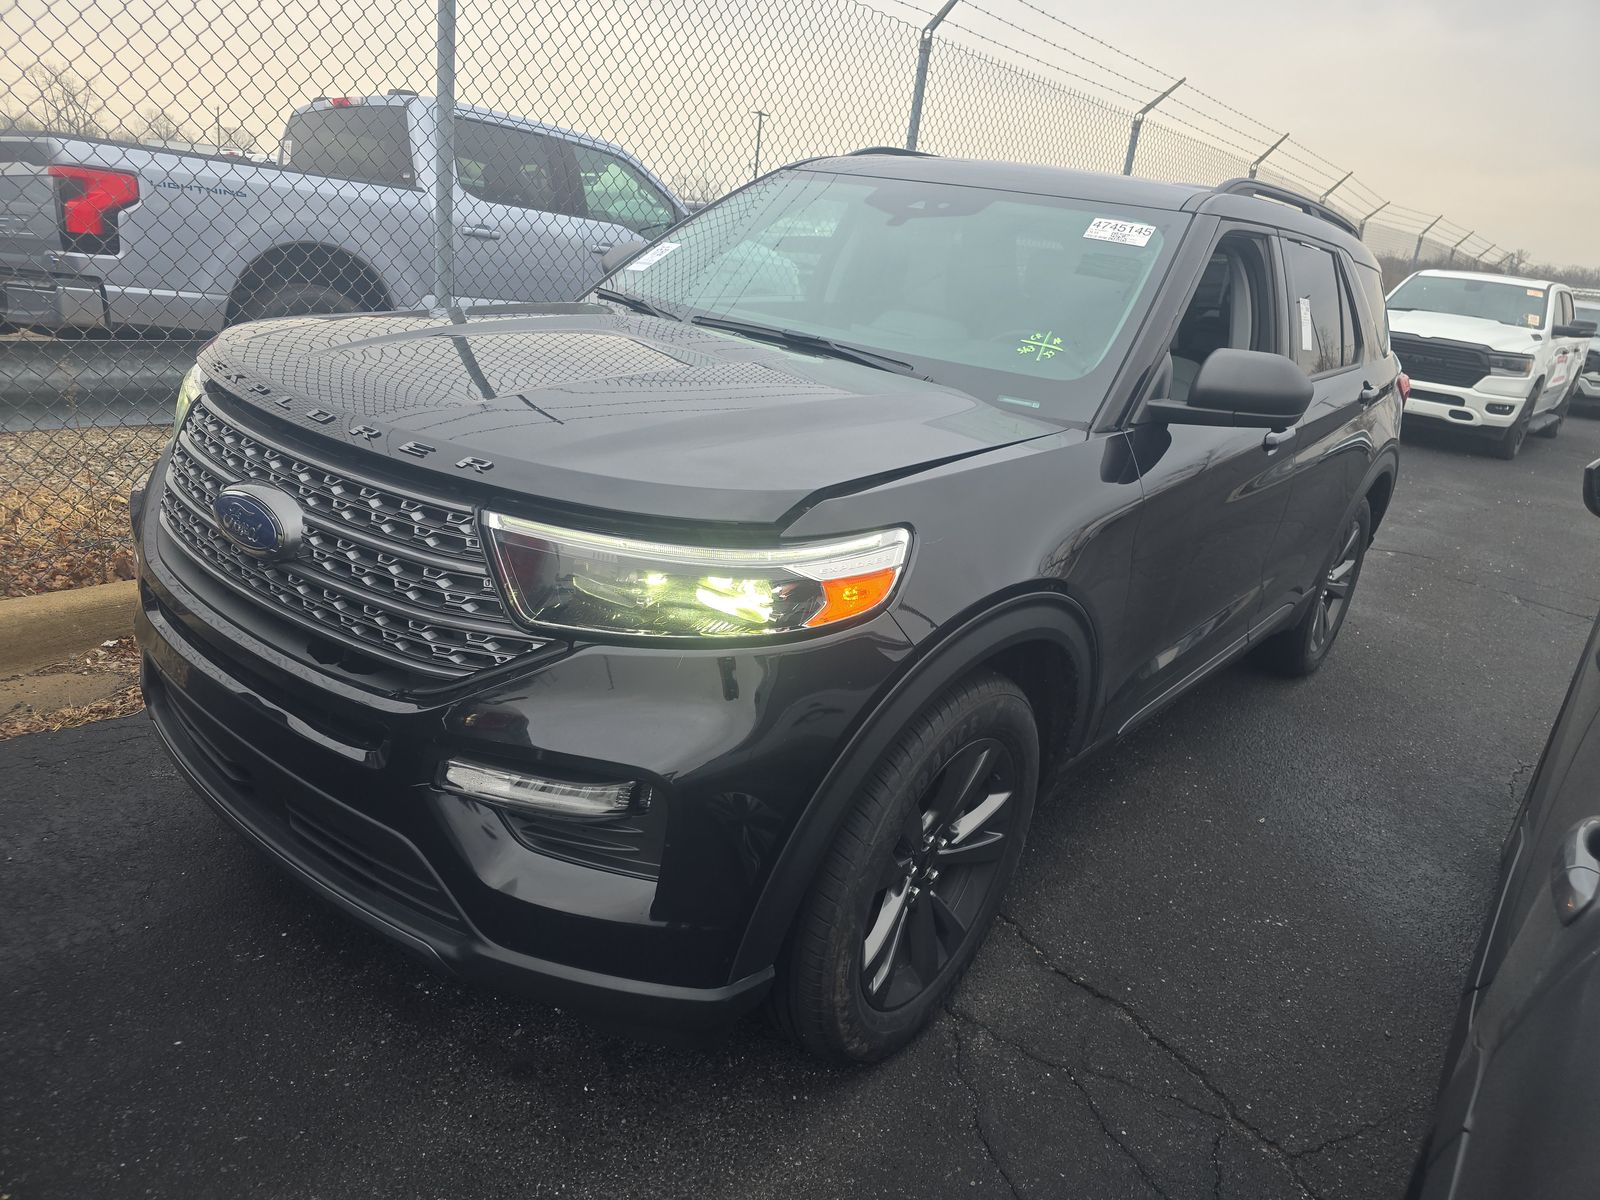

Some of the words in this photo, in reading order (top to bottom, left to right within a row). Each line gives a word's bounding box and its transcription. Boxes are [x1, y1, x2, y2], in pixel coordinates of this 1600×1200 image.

[149, 179, 247, 198] LIGHTNING
[1093, 220, 1154, 237] 4745145
[211, 360, 495, 475] EXPLORER
